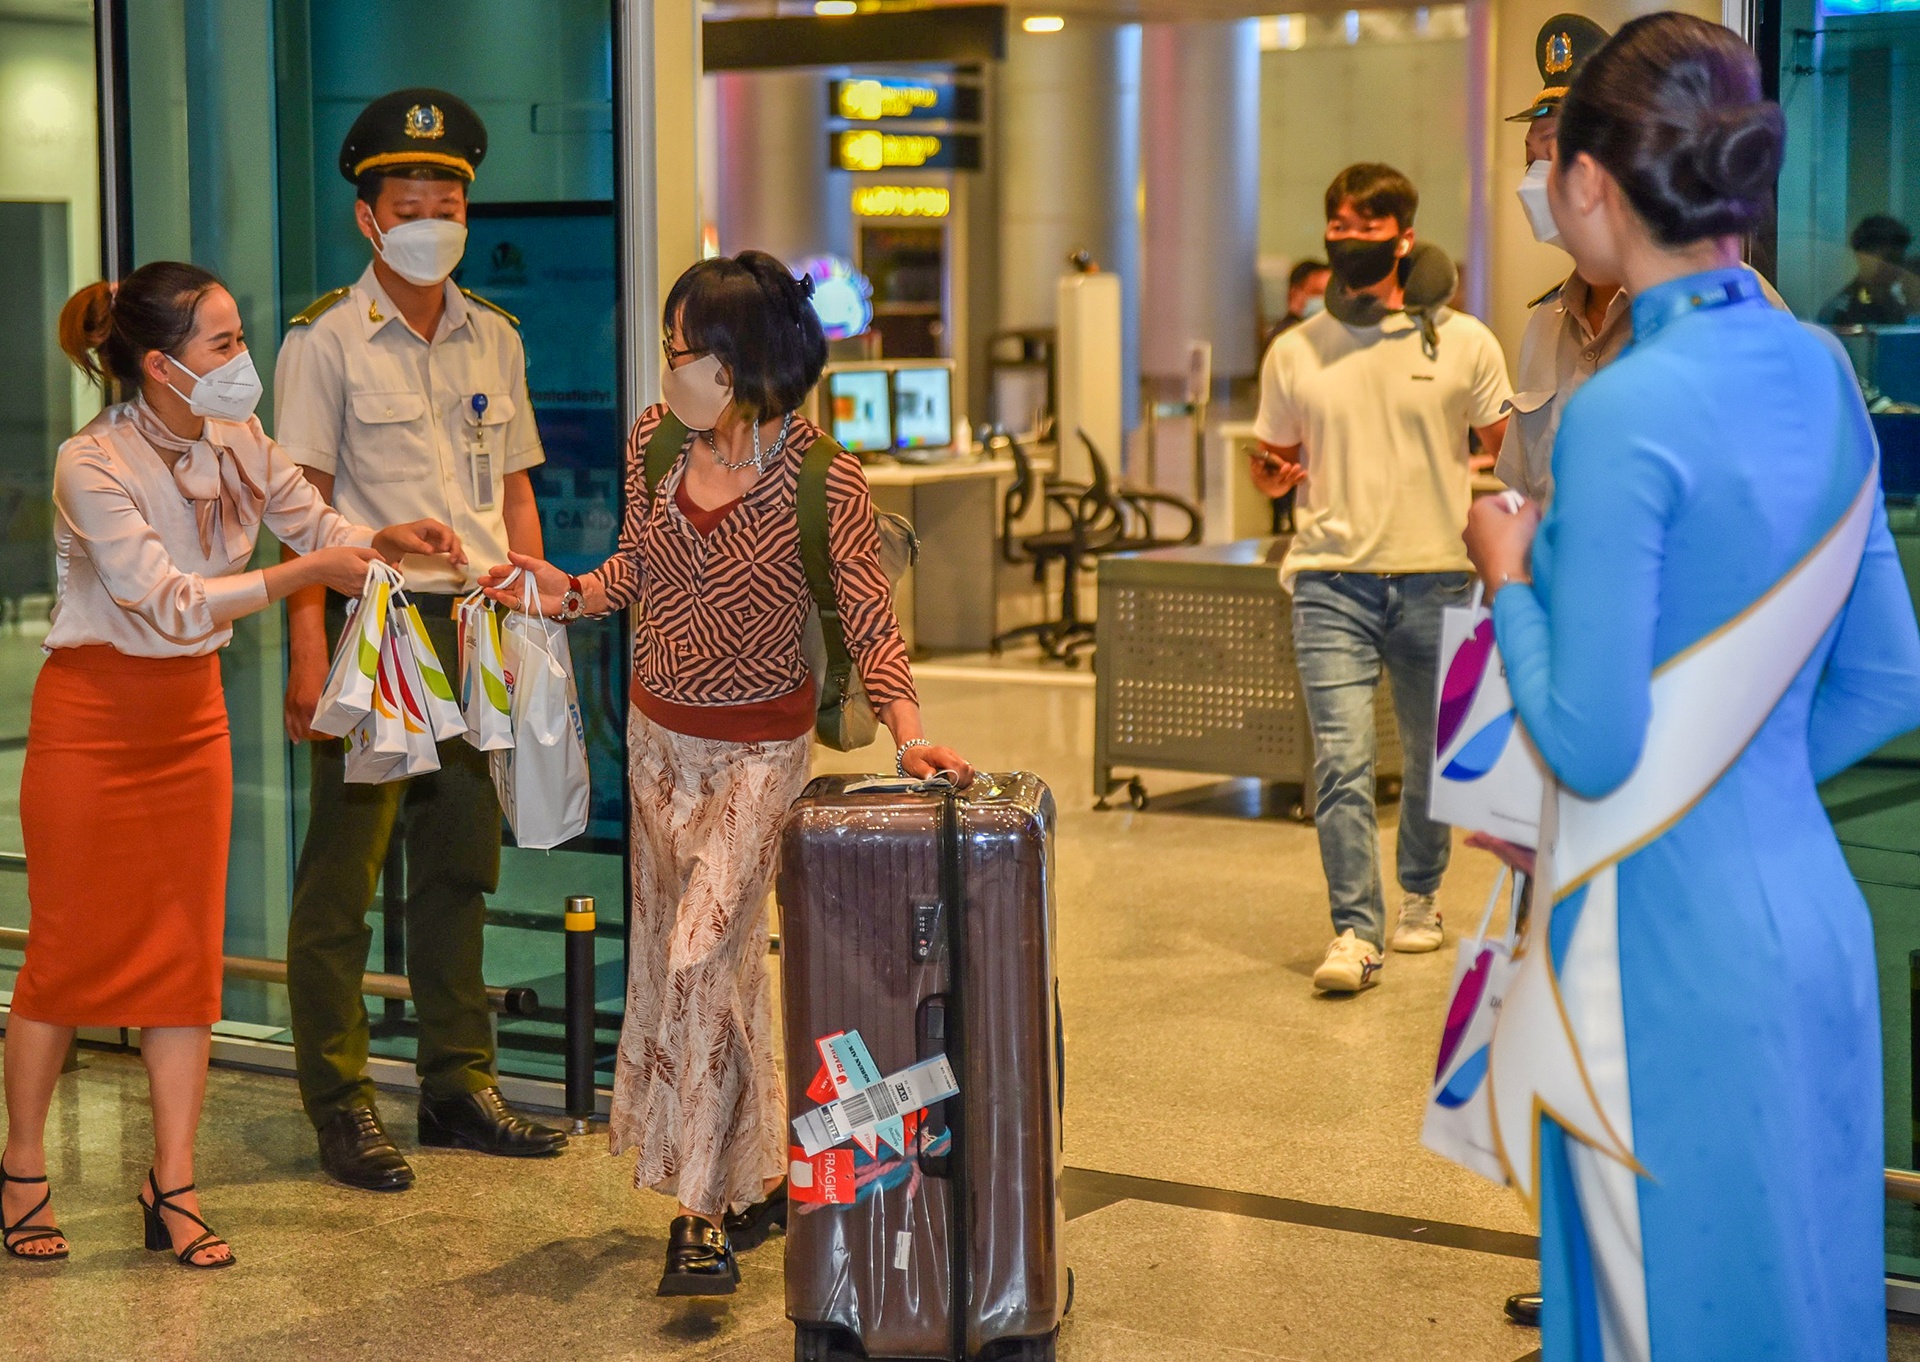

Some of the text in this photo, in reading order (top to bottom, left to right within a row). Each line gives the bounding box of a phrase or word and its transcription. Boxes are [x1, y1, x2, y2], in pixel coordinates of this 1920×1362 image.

[848, 1045, 858, 1058] AIR
[896, 1084, 909, 1102] DAD
[864, 1133, 874, 1152] FRAGILE
[825, 1152, 836, 1200] FRAGILE
